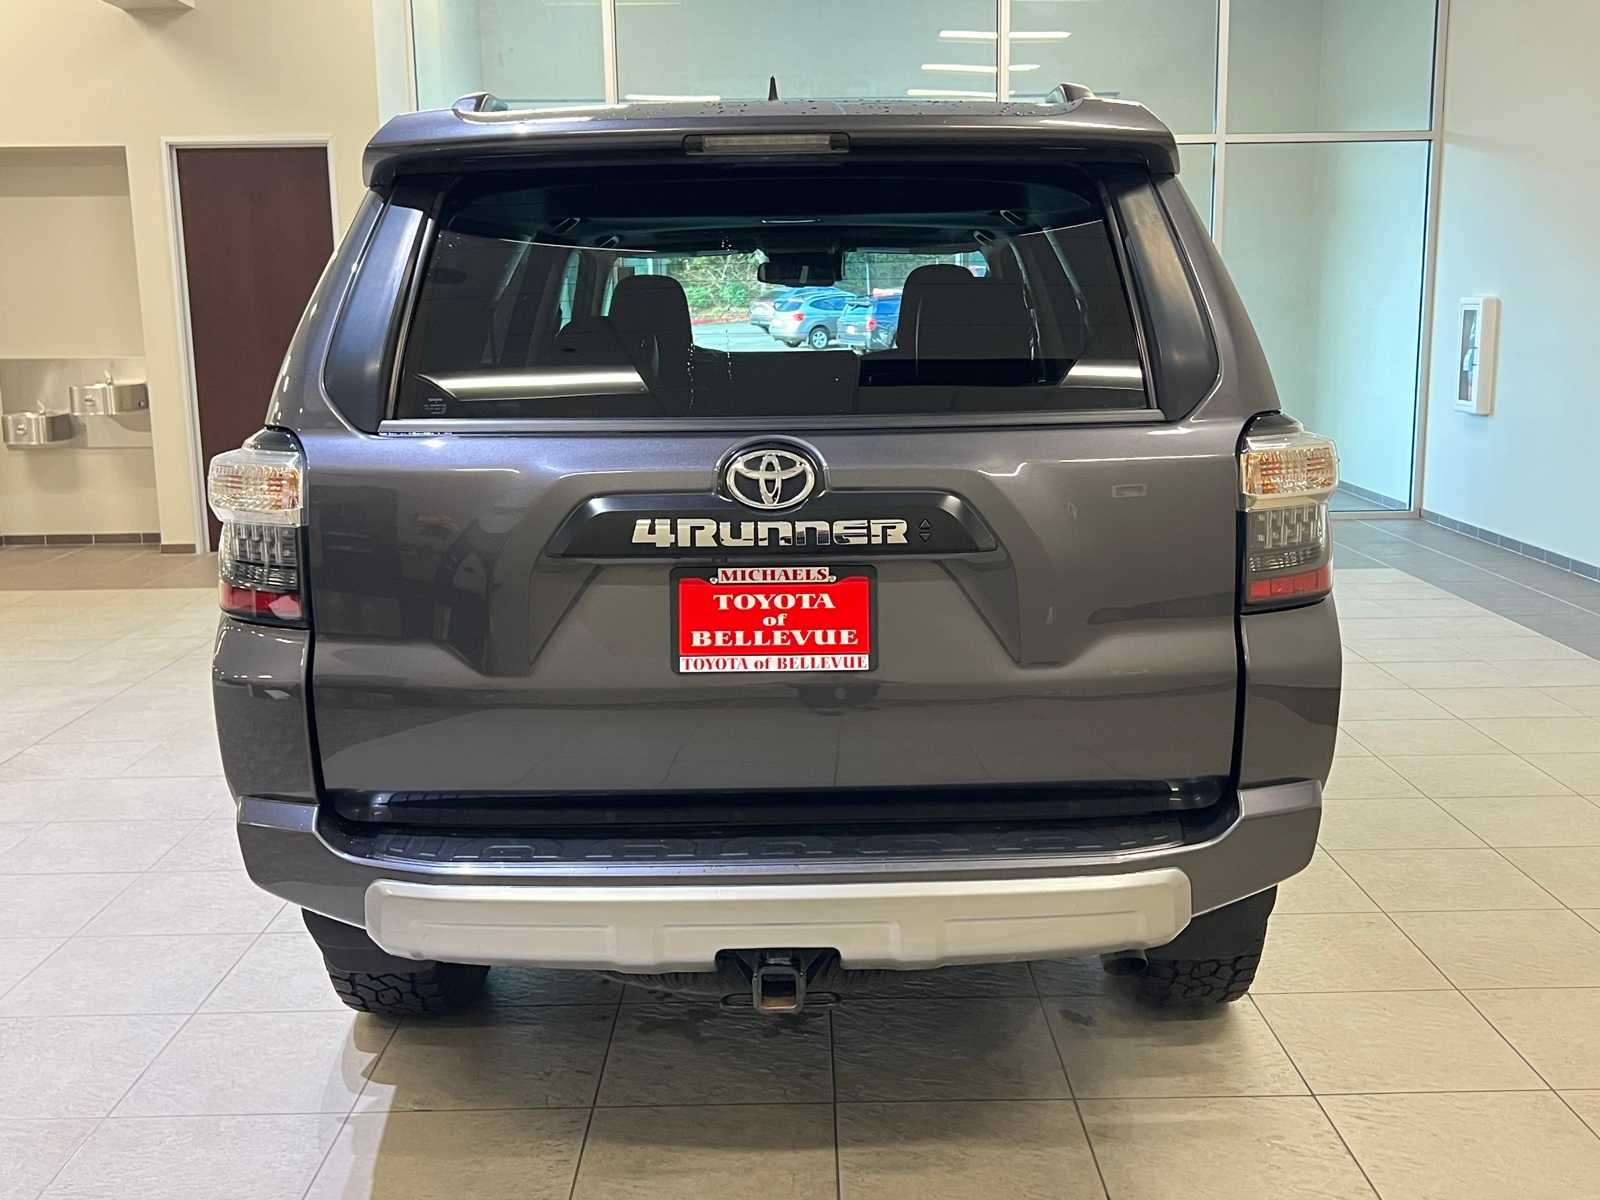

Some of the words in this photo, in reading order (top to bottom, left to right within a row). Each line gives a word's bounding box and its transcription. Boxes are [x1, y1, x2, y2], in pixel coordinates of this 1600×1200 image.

[720, 568, 828, 582] MICHAELS
[713, 593, 836, 610] TOYOTA
[762, 613, 787, 627] of
[691, 629, 858, 647] BELLEVUE
[681, 657, 748, 671] TOYOTA
[754, 657, 770, 670] of
[777, 655, 867, 670] BELLEVUE
